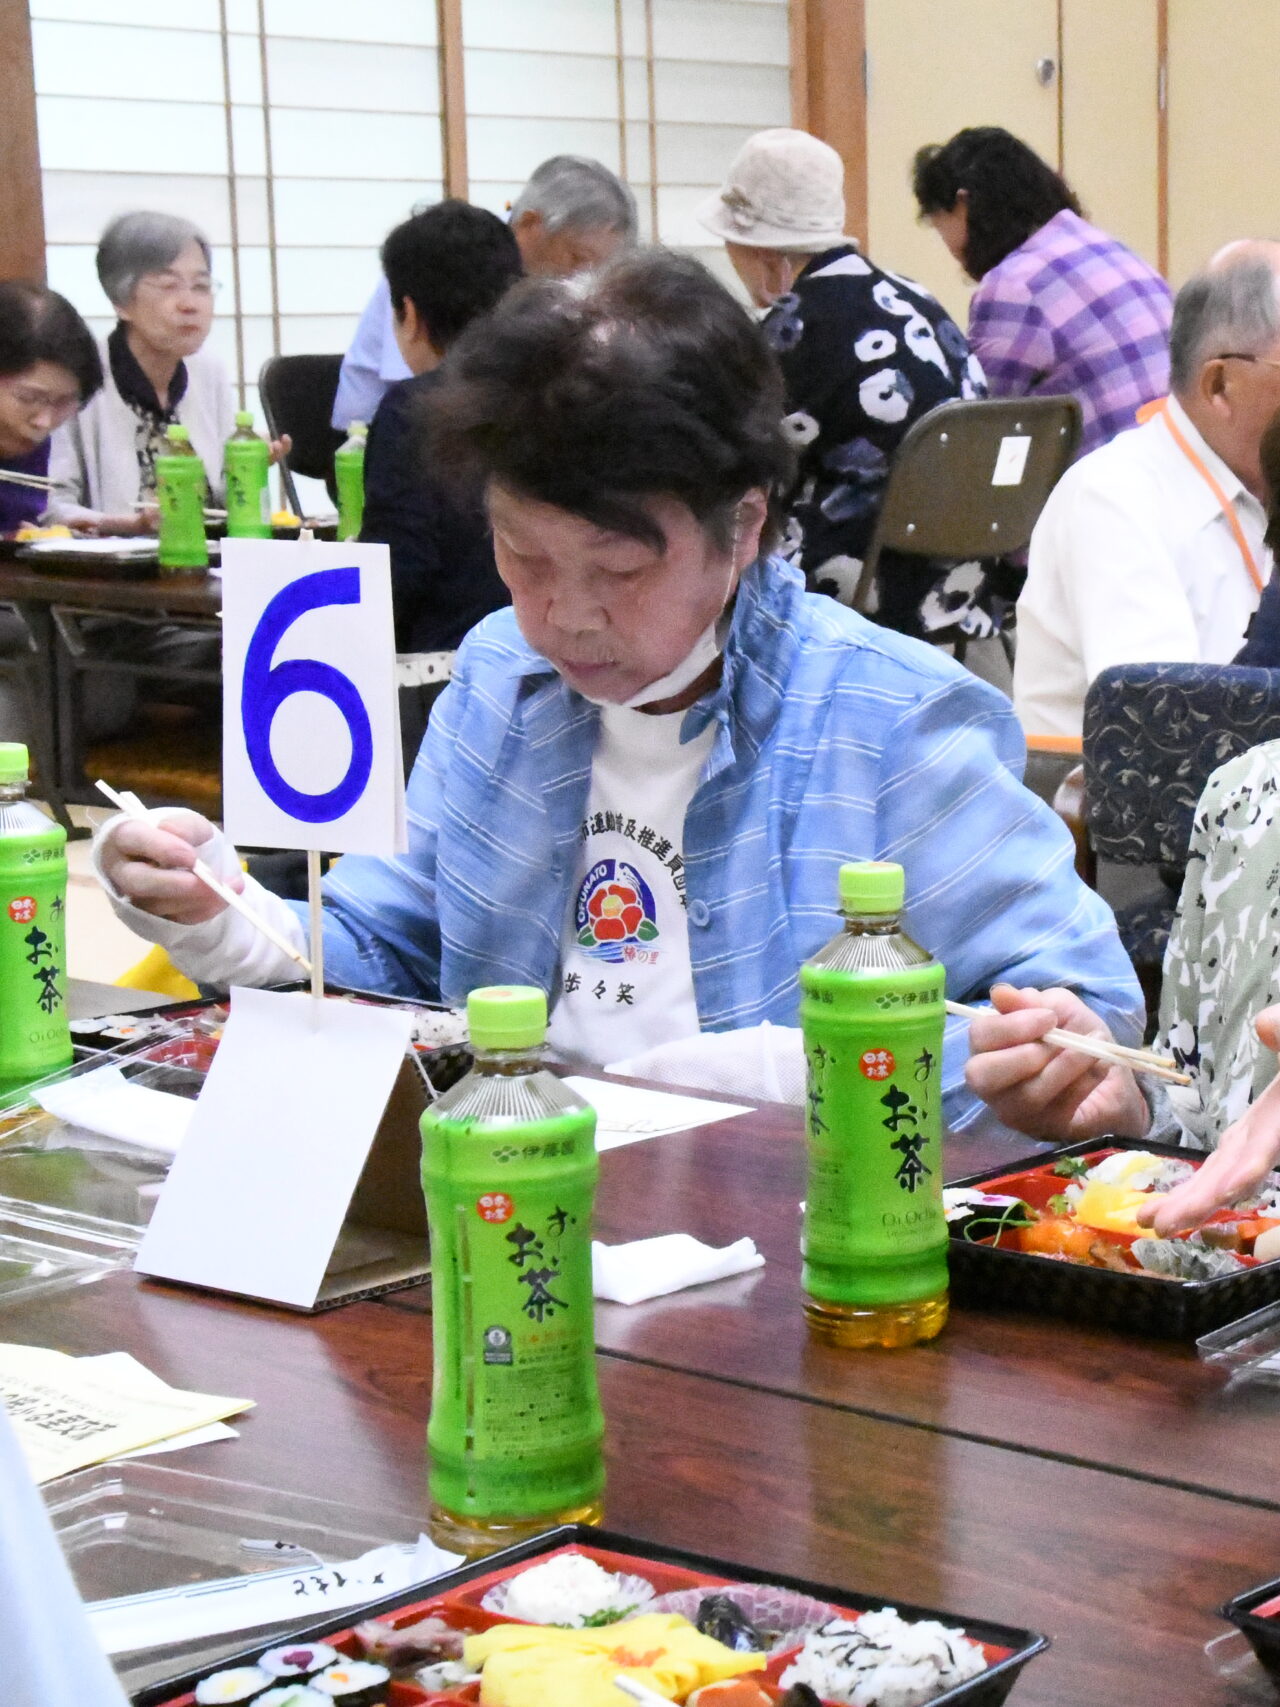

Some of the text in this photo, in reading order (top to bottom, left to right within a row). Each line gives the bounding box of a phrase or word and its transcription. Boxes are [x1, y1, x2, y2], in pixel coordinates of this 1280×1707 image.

[241, 567, 373, 823] 6
[880, 1083, 933, 1194] お茶
[505, 1221, 570, 1324] お茶
